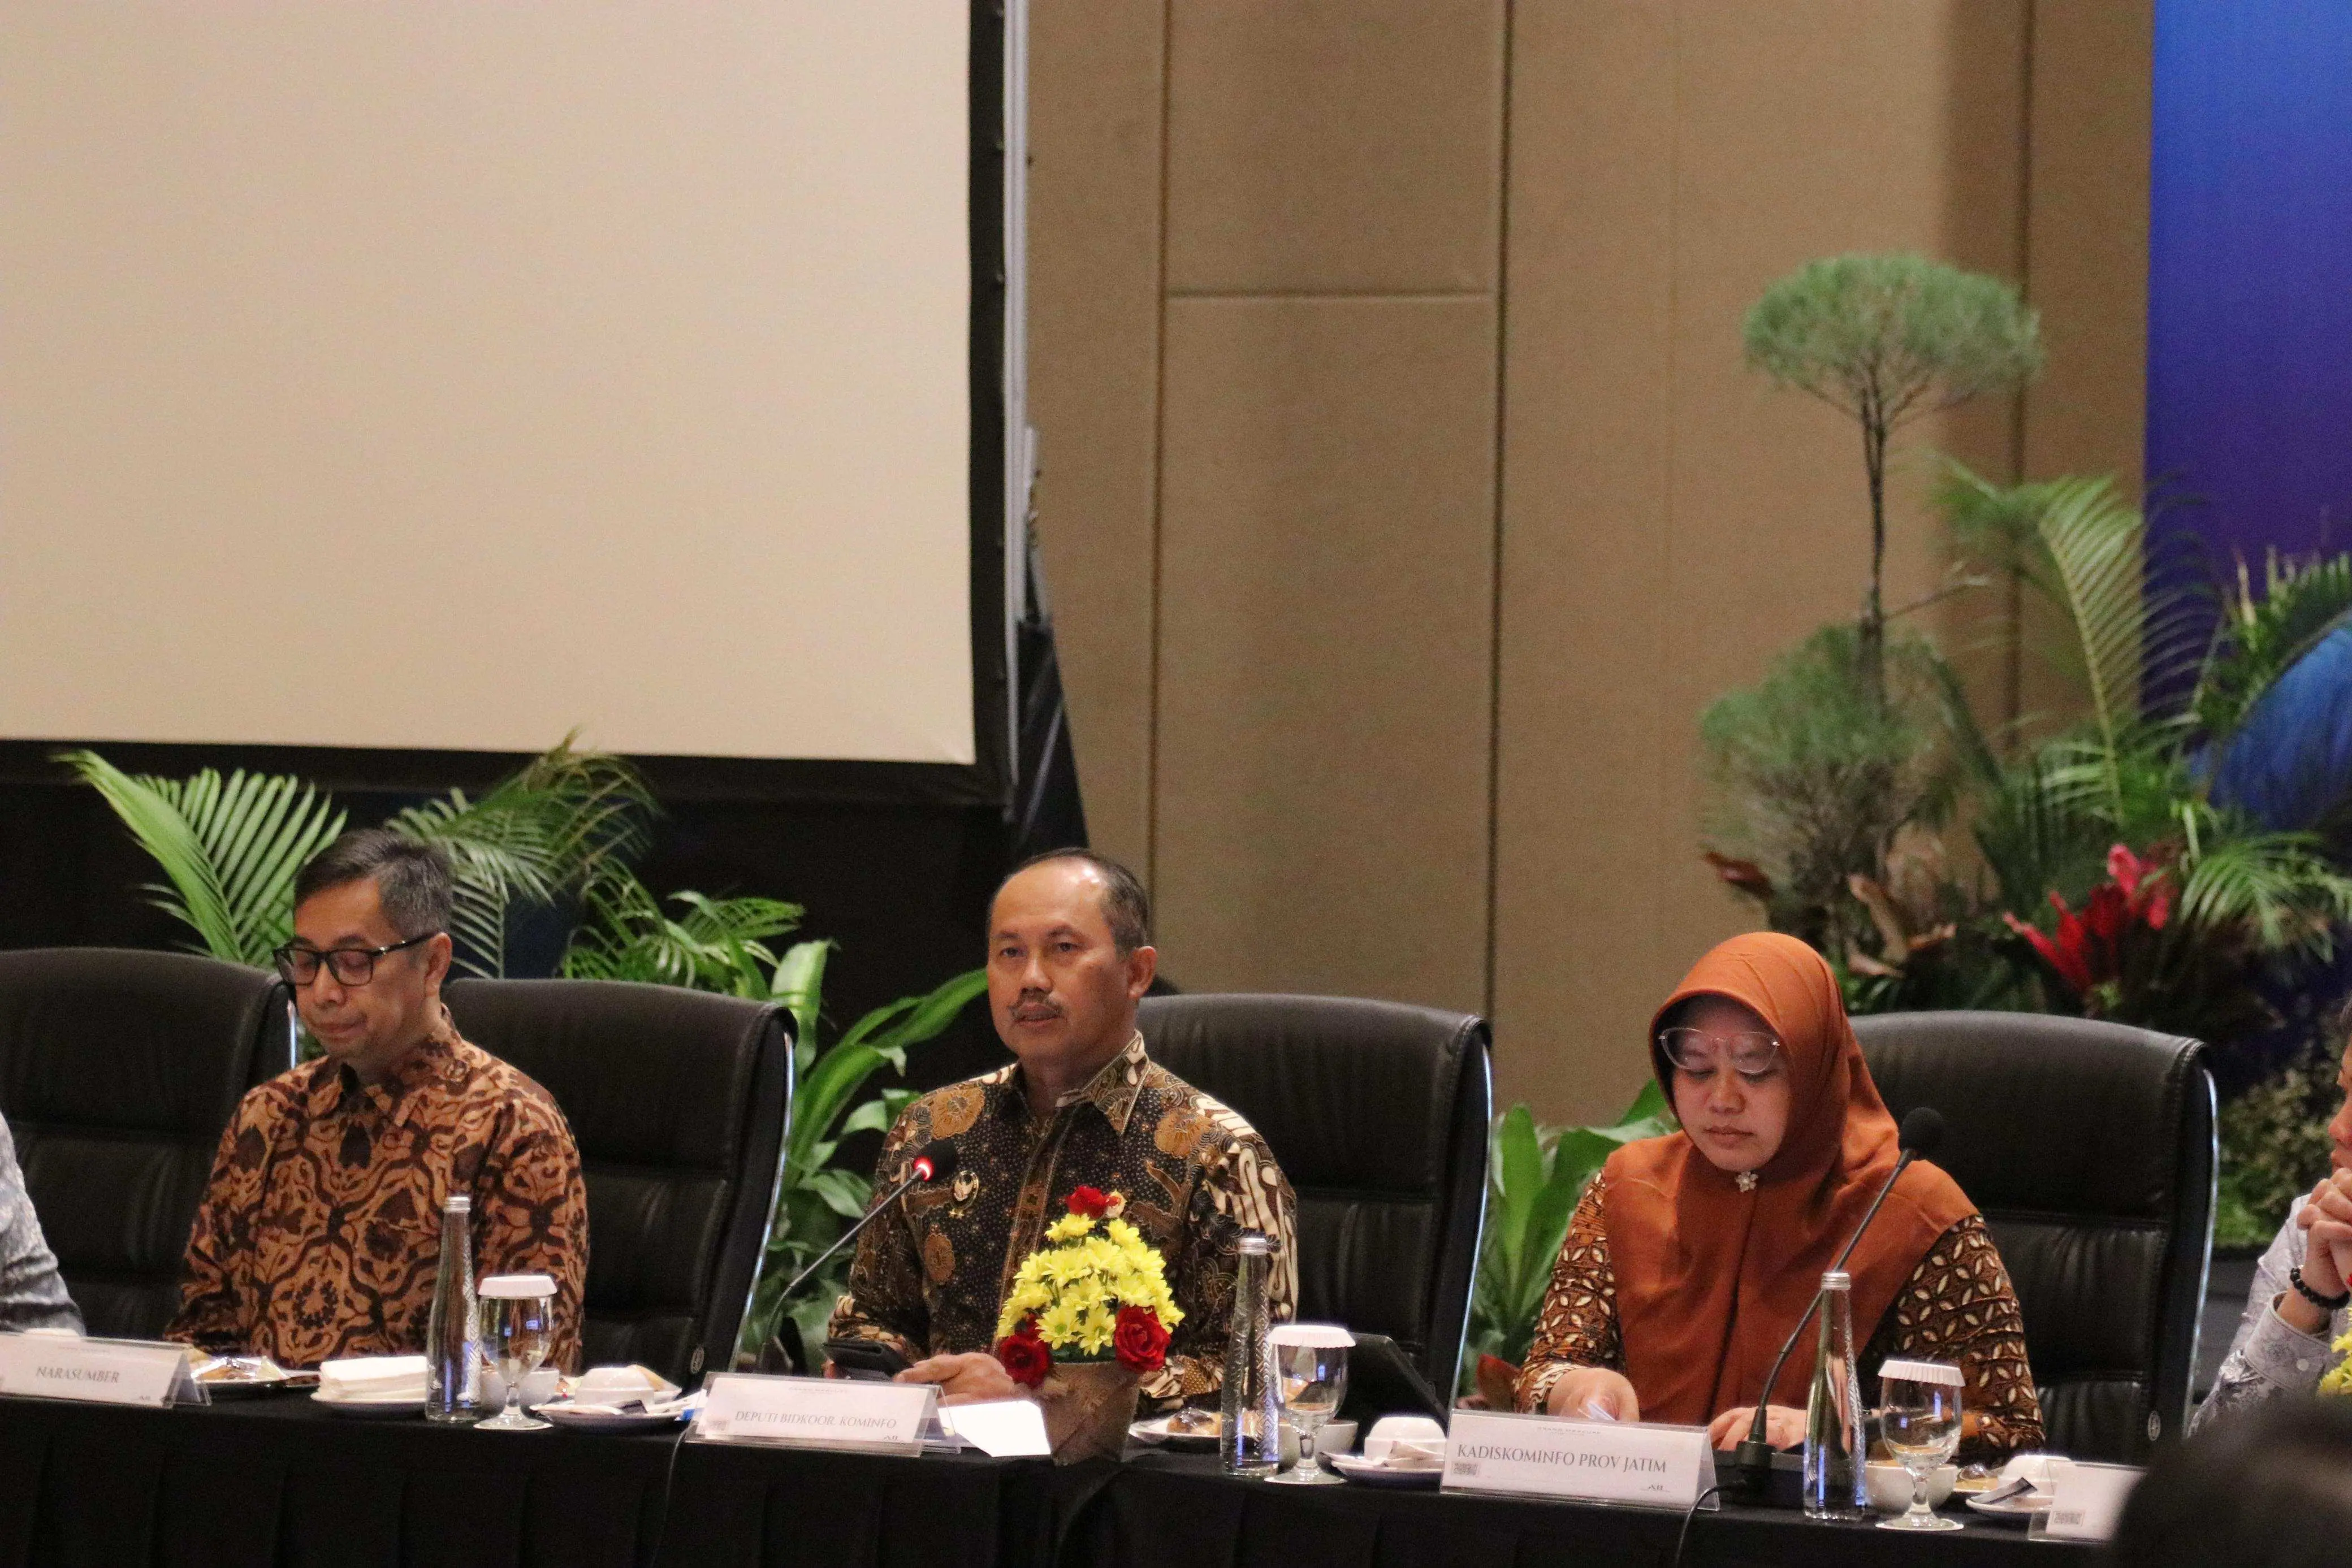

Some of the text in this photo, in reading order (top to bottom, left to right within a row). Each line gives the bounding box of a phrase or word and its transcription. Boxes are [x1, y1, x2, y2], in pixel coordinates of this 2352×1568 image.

[36, 1366, 120, 1383] NARASUMBER
[735, 1411, 779, 1423] DEPUTI
[840, 1417, 897, 1430] KOMINFO
[1457, 1444, 1666, 1473] KADISKOMINFO PROV JATIM
